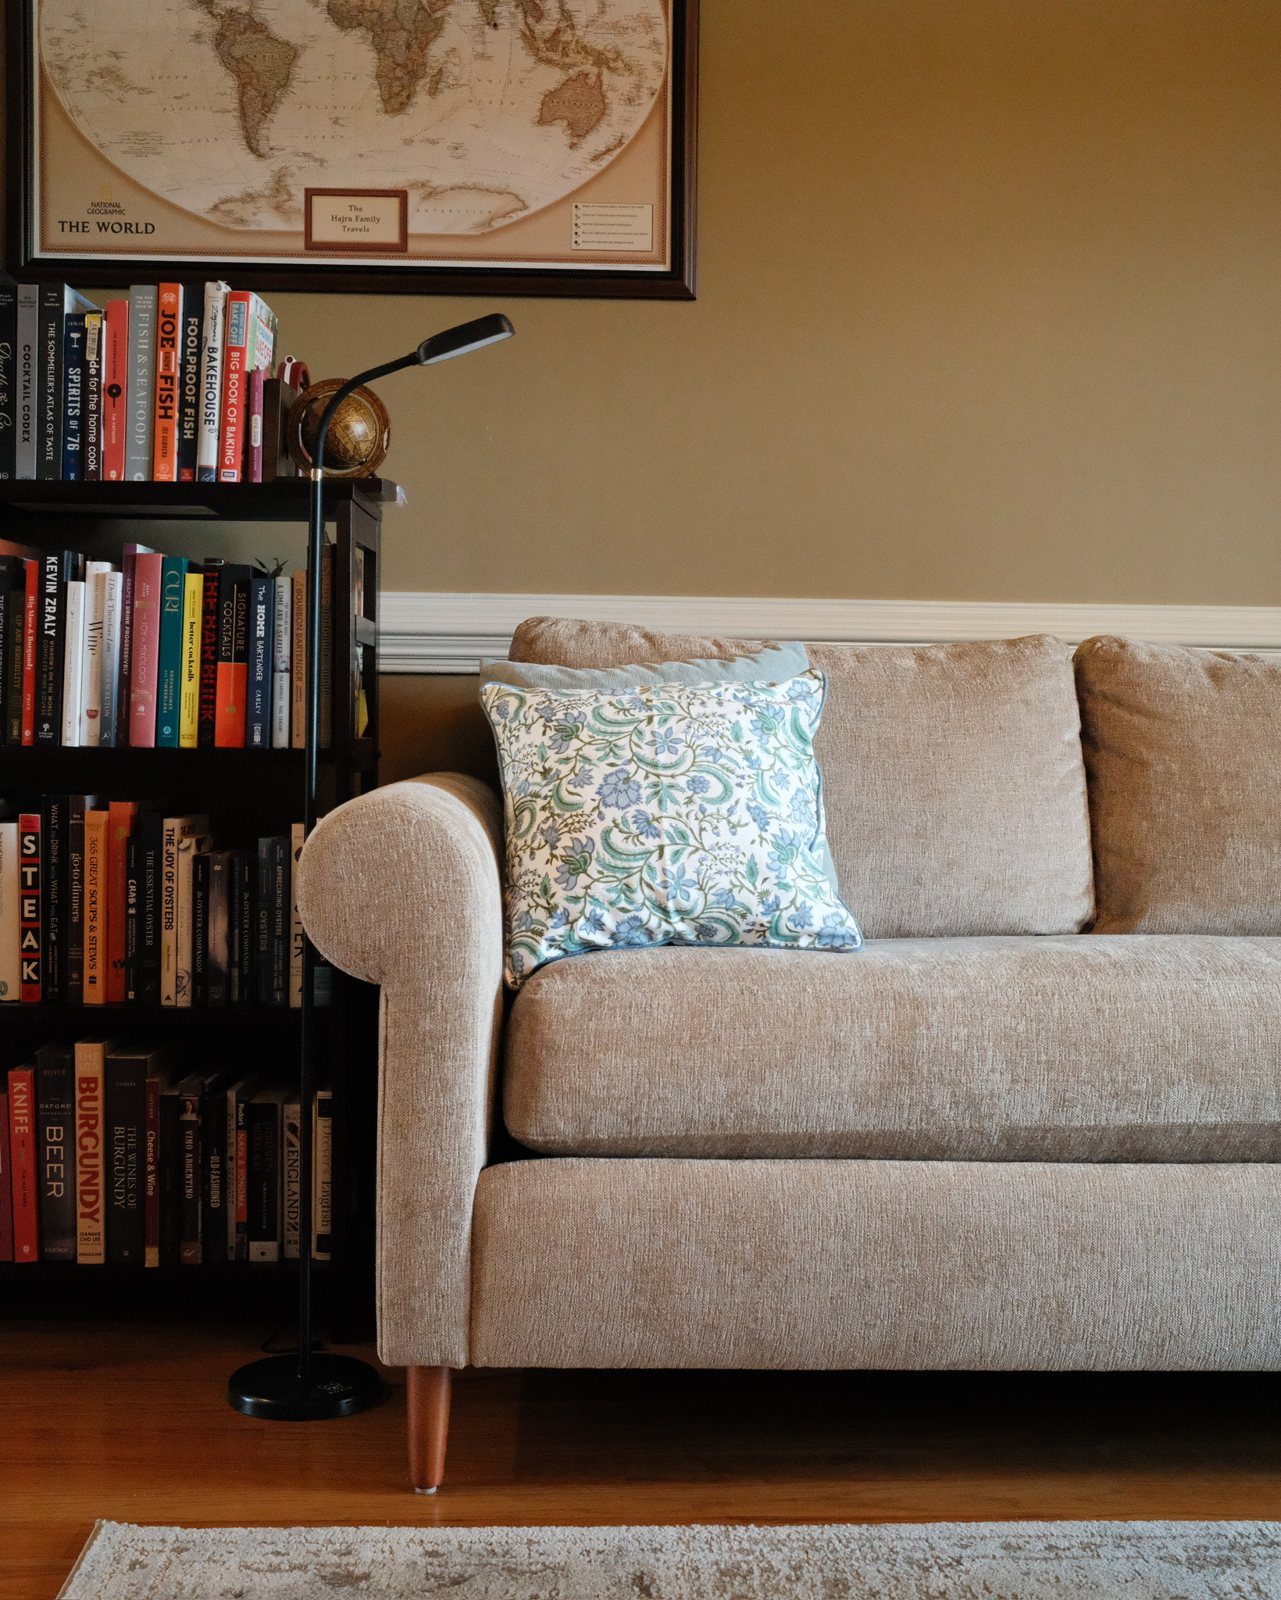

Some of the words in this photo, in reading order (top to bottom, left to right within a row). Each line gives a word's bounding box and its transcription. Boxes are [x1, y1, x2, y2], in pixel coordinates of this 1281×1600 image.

[58, 221, 90, 233] THE
[96, 222, 155, 234] WORLD
[331, 215, 352, 223] Hajra
[355, 215, 381, 223] Family
[342, 225, 370, 233] Travels
[160, 309, 176, 348] JOE
[231, 304, 239, 325] BAKE
[48, 322, 56, 342] THE
[138, 313, 150, 349] FISH
[229, 327, 238, 345] OFF
[22, 344, 31, 402] COCKTAIL
[47, 344, 56, 395] SOMMELIER'S
[137, 354, 147, 364] &
[162, 351, 171, 372] KNOWS
[184, 317, 198, 404] FOOLPROOF
[230, 351, 240, 370] BIG
[67, 367, 81, 417] SPIRITS
[89, 377, 99, 391] for
[158, 374, 175, 420] FISH
[204, 346, 219, 426] BAKEHOUSE
[228, 373, 238, 404] BOOK
[46, 395, 54, 420] ATLAS
[89, 393, 99, 410] the
[135, 368, 148, 445] SEAFOOD
[227, 407, 237, 423] OF
[22, 404, 31, 443] CODEX
[46, 423, 54, 434] OF
[69, 420, 79, 430] OF
[89, 413, 99, 443] home
[183, 408, 195, 439] FISH
[46, 436, 54, 461] TASTE
[67, 433, 81, 451] '76
[88, 445, 98, 471] cook
[225, 426, 236, 465] BAKING
[45, 556, 58, 593] KEVIN
[204, 572, 219, 608] THE
[27, 595, 35, 608] Big
[107, 583, 115, 603] Drink
[257, 585, 266, 601] The
[276, 590, 284, 607] LIME
[44, 598, 57, 637] ZRALY
[235, 592, 247, 652] SIGNATURE
[256, 604, 266, 638] HOME
[276, 608, 284, 622] AND
[295, 588, 303, 632] BOURBON
[87, 620, 103, 656] Wine
[140, 620, 148, 636] JOY
[188, 621, 196, 646] better
[203, 615, 218, 661] BAR
[222, 601, 233, 657] COCKTAILS
[275, 630, 284, 654] SHAKER
[25, 636, 34, 671] Burgundy
[122, 626, 130, 676] PROGRESSIVELY
[139, 644, 148, 685] MIXOLOGY
[187, 646, 195, 683] cocktails
[255, 640, 265, 682] BARTENDER
[295, 632, 303, 682] BARTENDER
[50, 839, 58, 864] DRINK
[89, 836, 98, 854] 365
[165, 827, 175, 847] THE
[70, 853, 82, 880] go-to
[89, 856, 98, 888] GREAT
[146, 850, 155, 869] THE
[165, 849, 175, 868] JOY
[128, 879, 137, 905] CRAB
[146, 869, 155, 913] ESSENTIAL
[165, 871, 175, 884] OF
[275, 865, 283, 908] APPRECIATING
[22, 834, 39, 981] STEAK
[72, 881, 82, 923] dinners
[89, 889, 98, 922] SOUPS
[164, 885, 175, 931] OYSTERS
[195, 901, 203, 928] OYSTER
[242, 900, 250, 929] OYSTER
[89, 924, 98, 932] &
[145, 914, 154, 946] OYSTER
[259, 910, 267, 951] OYSTERS
[88, 936, 97, 970] STEWS
[195, 928, 203, 973] COMPANION
[13, 1082, 28, 1134] KNIFE
[78, 1076, 100, 1223] BURGUNDY
[127, 1125, 136, 1150] THE
[146, 1130, 156, 1163] Cheese
[185, 1130, 193, 1150] VINO
[237, 1133, 245, 1157] NAPA
[46, 1126, 64, 1198] BEER
[113, 1126, 125, 1209] BURGUNDY
[127, 1152, 136, 1189] WINES
[184, 1152, 193, 1199] ARGENTINO
[127, 1193, 136, 1209] OF
[146, 1173, 156, 1197] Wine
[237, 1168, 245, 1208] SONOMA
[287, 1150, 299, 1220] ENGLAND
[319, 1180, 332, 1227] English
